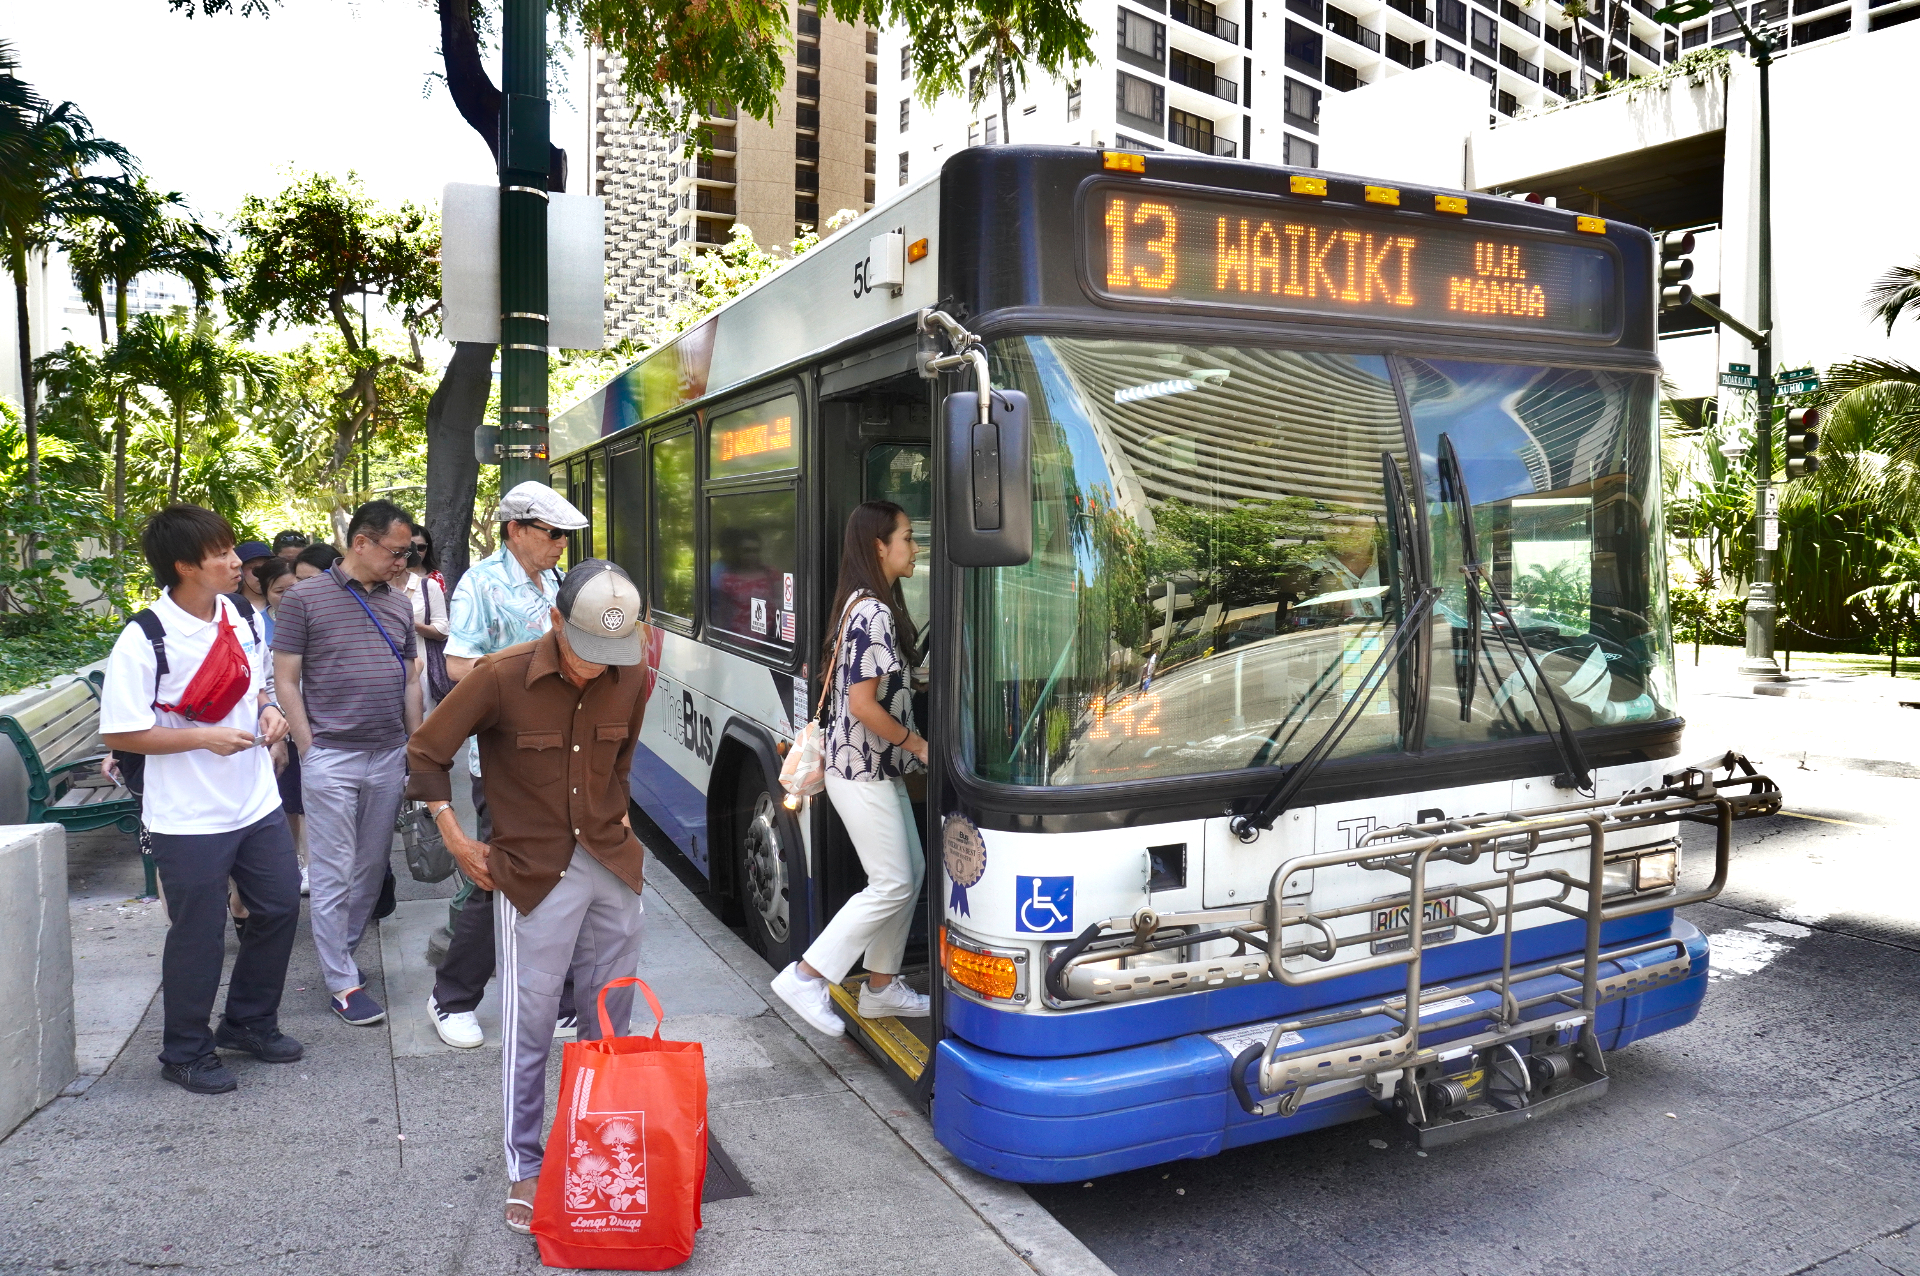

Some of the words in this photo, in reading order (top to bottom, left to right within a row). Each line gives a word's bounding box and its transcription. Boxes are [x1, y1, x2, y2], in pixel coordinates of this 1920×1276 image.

[1105, 198, 1178, 290] 13
[1216, 216, 1417, 306] WAIKIKI
[1476, 242, 1526, 279] U.H.
[1450, 276, 1545, 317] MANOA
[1778, 382, 1804, 394] KUHIO
[658, 676, 713, 767] TheBus
[1089, 693, 1161, 739] 142
[571, 1217, 607, 1229] Longs
[609, 1215, 641, 1229] Drugs
